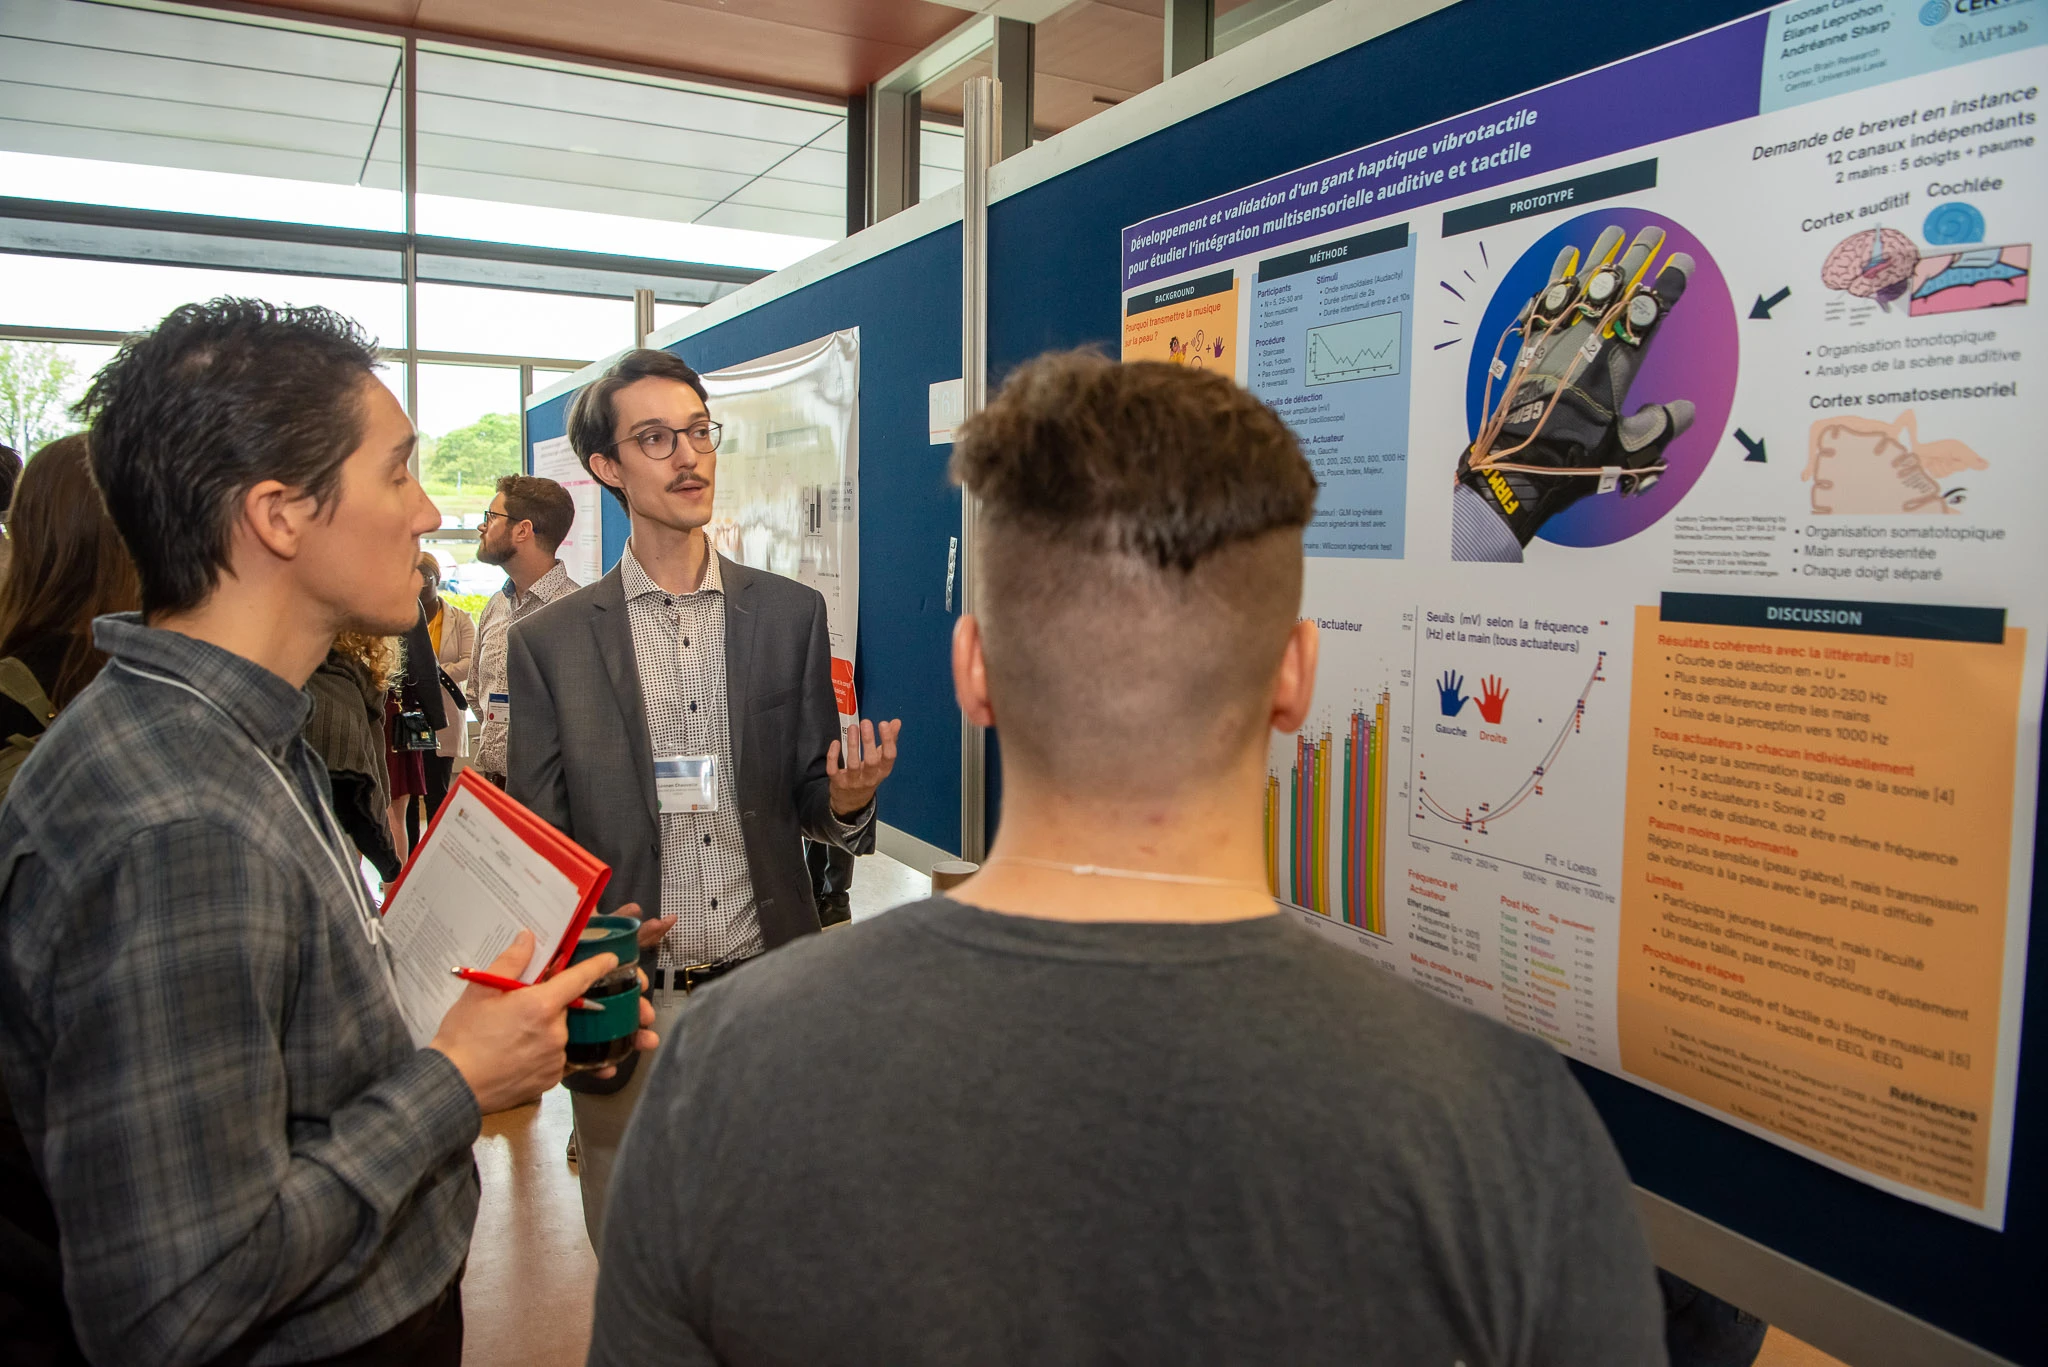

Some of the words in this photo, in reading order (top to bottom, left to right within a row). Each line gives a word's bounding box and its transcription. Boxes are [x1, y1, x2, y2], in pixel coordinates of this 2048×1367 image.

[1785, 5, 1829, 24] Loonan
[1752, 134, 1828, 161] Demande
[1832, 129, 1854, 144] de
[1858, 113, 1916, 138] brevet
[1921, 110, 1945, 124] en
[1949, 89, 2038, 118] instance
[1827, 152, 1842, 166] 12
[1846, 142, 1905, 162] canaux
[1909, 115, 2037, 149] indépendants
[1847, 166, 1889, 182] mains
[1912, 151, 1960, 169] doigts
[1977, 138, 2034, 159] paume
[1130, 212, 1207, 252] Développement
[1209, 208, 1222, 227] et
[1224, 191, 1286, 223] validation
[1288, 181, 1318, 203] d'un
[1320, 166, 1354, 197] gant
[1357, 146, 1427, 182] haptique
[1432, 111, 1537, 158] vibrotactile
[1926, 179, 2003, 198] Cochlée
[1128, 258, 1148, 278] pour
[1150, 246, 1186, 269] étudier
[1188, 225, 1259, 257] l'intégration
[1262, 190, 1373, 236] multisensorielle
[1376, 170, 1444, 203] auditive
[1447, 160, 1466, 182] et
[1470, 144, 1531, 175] tactile
[1510, 185, 1574, 214] PROTOTYPE
[1801, 211, 1854, 233] Cortex
[1858, 194, 1911, 218] auditif
[1309, 246, 1348, 264] MÉTHODE
[1316, 273, 1338, 285] Stimuli
[1155, 286, 1195, 303] BACKGROUND
[1258, 284, 1291, 298] Participants
[1125, 321, 1148, 333] Pourquoi
[1149, 313, 1184, 327] transmettre
[1193, 304, 1221, 317] musique
[1138, 335, 1153, 346] peau
[1255, 336, 1286, 347] Procédure
[1816, 341, 1901, 358] Organisation
[1904, 332, 1996, 348] tonotopique
[1816, 364, 1868, 376] Analyse
[1870, 361, 1889, 372] de
[1892, 360, 1906, 370] la
[1908, 356, 1954, 369] scène
[1957, 351, 2022, 365] auditive
[1293, 393, 1323, 403] détection
[1809, 394, 1862, 408] Cortex
[1866, 382, 2017, 405] somatosensoriel
[1312, 434, 1344, 442] Actuateur
[1805, 527, 1887, 541] Organisation
[1889, 527, 2006, 540] somatotopique
[1802, 565, 1852, 580] Chaque
[1854, 567, 1889, 581] doigt
[1892, 568, 1942, 582] séparé
[1317, 618, 1363, 632] l'actuateur
[1426, 612, 1455, 623] Seuils
[1459, 614, 1481, 628] (mV)
[1485, 617, 1514, 628] selon
[1533, 619, 1589, 634] fréquence
[1766, 606, 1863, 625] DISCUSSION
[1426, 630, 1443, 643] (Hz)
[1467, 634, 1491, 644] main
[1492, 634, 1518, 647] (tous
[1519, 637, 1580, 654] actuateurs)
[1657, 634, 1710, 650] Résultats
[1712, 640, 1773, 655] cohérents
[1775, 647, 1805, 657] avec
[1808, 647, 1821, 659] la
[1823, 648, 1891, 664] littérature
[1674, 653, 1715, 667] Courbe
[1717, 657, 1733, 669] de
[1734, 658, 1792, 673] détection
[1794, 666, 1811, 675] en
[1674, 670, 1697, 684] Plus
[1699, 676, 1747, 689] sensible
[1749, 680, 1787, 693] autour
[1790, 682, 1807, 695] de
[1809, 684, 1867, 702] 200-250
[1868, 691, 1888, 704] Hz
[1673, 688, 1693, 701] Pas
[1695, 691, 1710, 703] de
[1773, 701, 1807, 714] entre
[1809, 703, 1829, 717] les
[1831, 708, 1871, 722] mains
[1435, 724, 1468, 737] Gauche
[1672, 706, 1704, 721] Limite
[1706, 710, 1721, 723] de
[1723, 712, 1735, 725] la
[1736, 717, 1802, 734] perception
[1804, 726, 1832, 738] vers
[1836, 727, 1868, 743] 1000
[1870, 732, 1889, 745] Hz
[1479, 731, 1508, 744] Droite
[1653, 728, 1679, 742] Tous
[1681, 733, 1743, 751] actuateurs
[1755, 743, 1801, 759] chacun
[1802, 749, 1916, 776] individuellement
[1648, 816, 1685, 835] Paume
[1686, 827, 1721, 842] moins
[1723, 834, 1799, 857] performante
[1646, 872, 1684, 891] Limites
[1642, 944, 1702, 972] Prochaines
[1704, 962, 1745, 984] étapes
